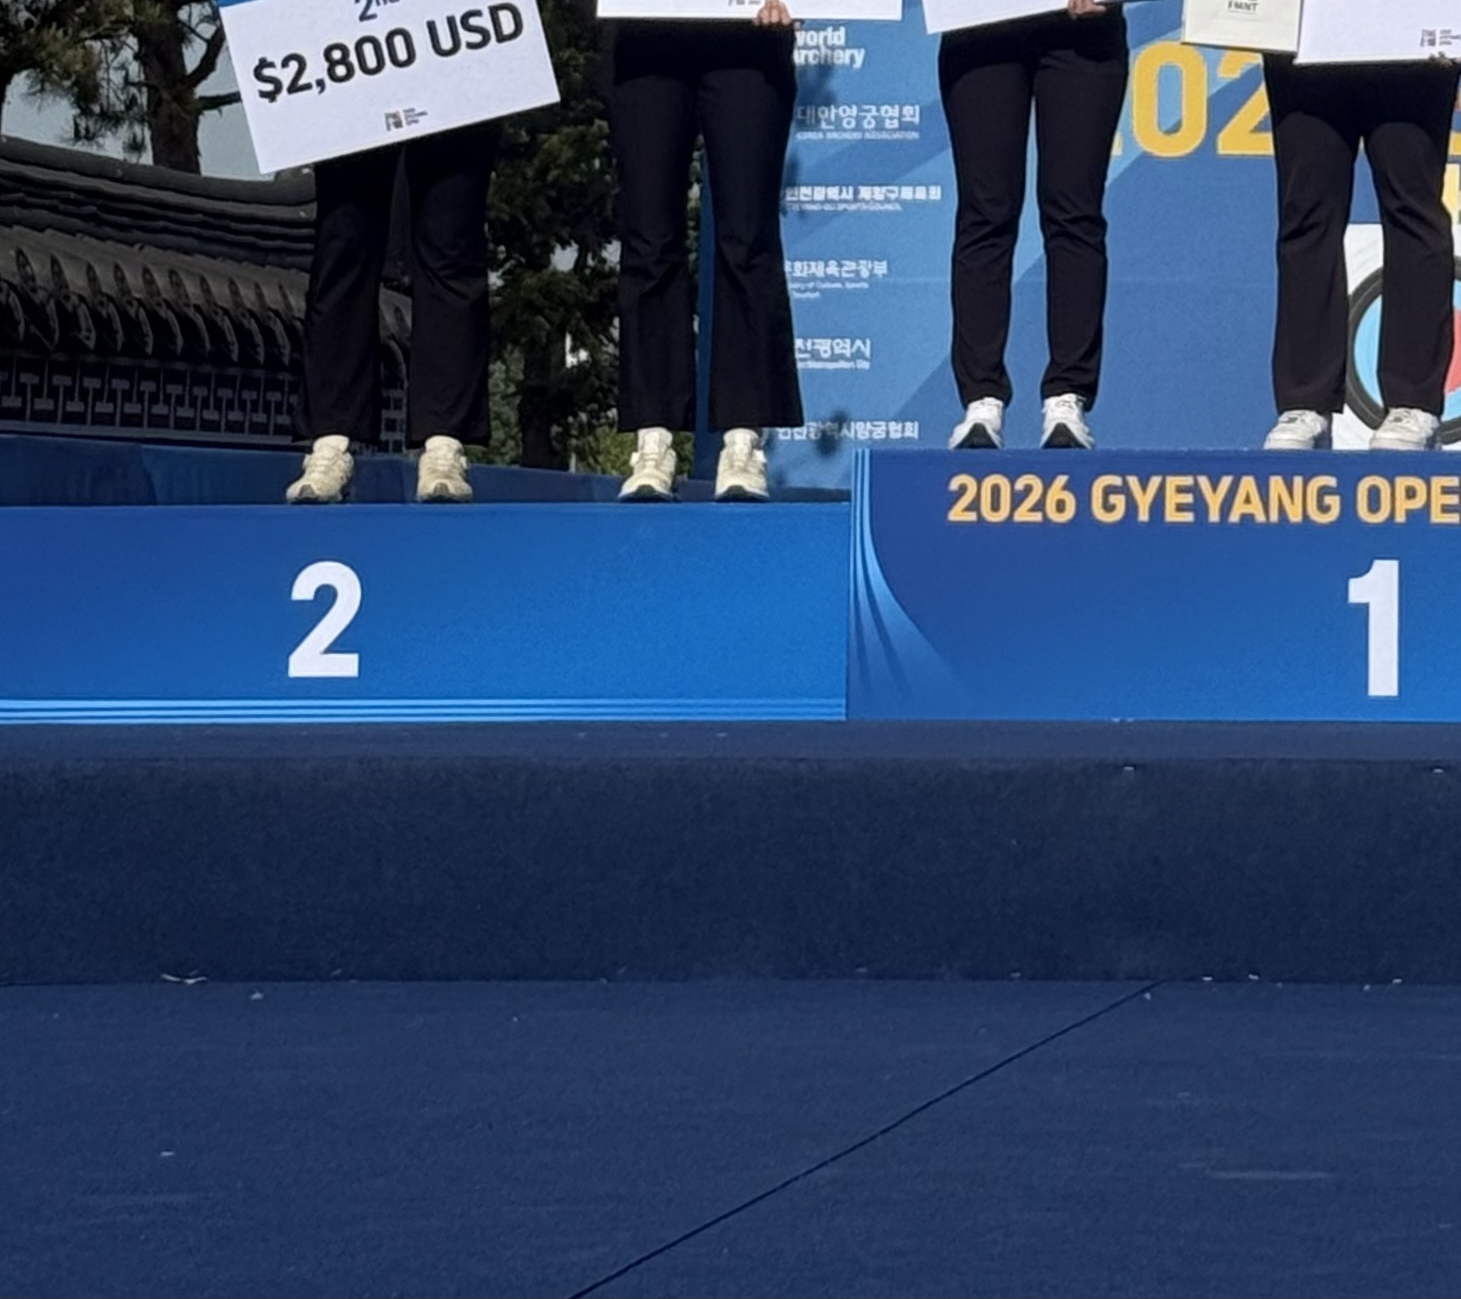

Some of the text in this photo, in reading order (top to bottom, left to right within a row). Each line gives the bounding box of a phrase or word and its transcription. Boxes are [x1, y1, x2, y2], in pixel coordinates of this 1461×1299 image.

[253, 3, 523, 102] $2,800 USD
[794, 337, 871, 359] 천광역시
[947, 475, 1075, 524] 2026
[1092, 475, 1340, 524] GYEYANG
[288, 561, 362, 678] 2
[1348, 559, 1400, 698] 1
